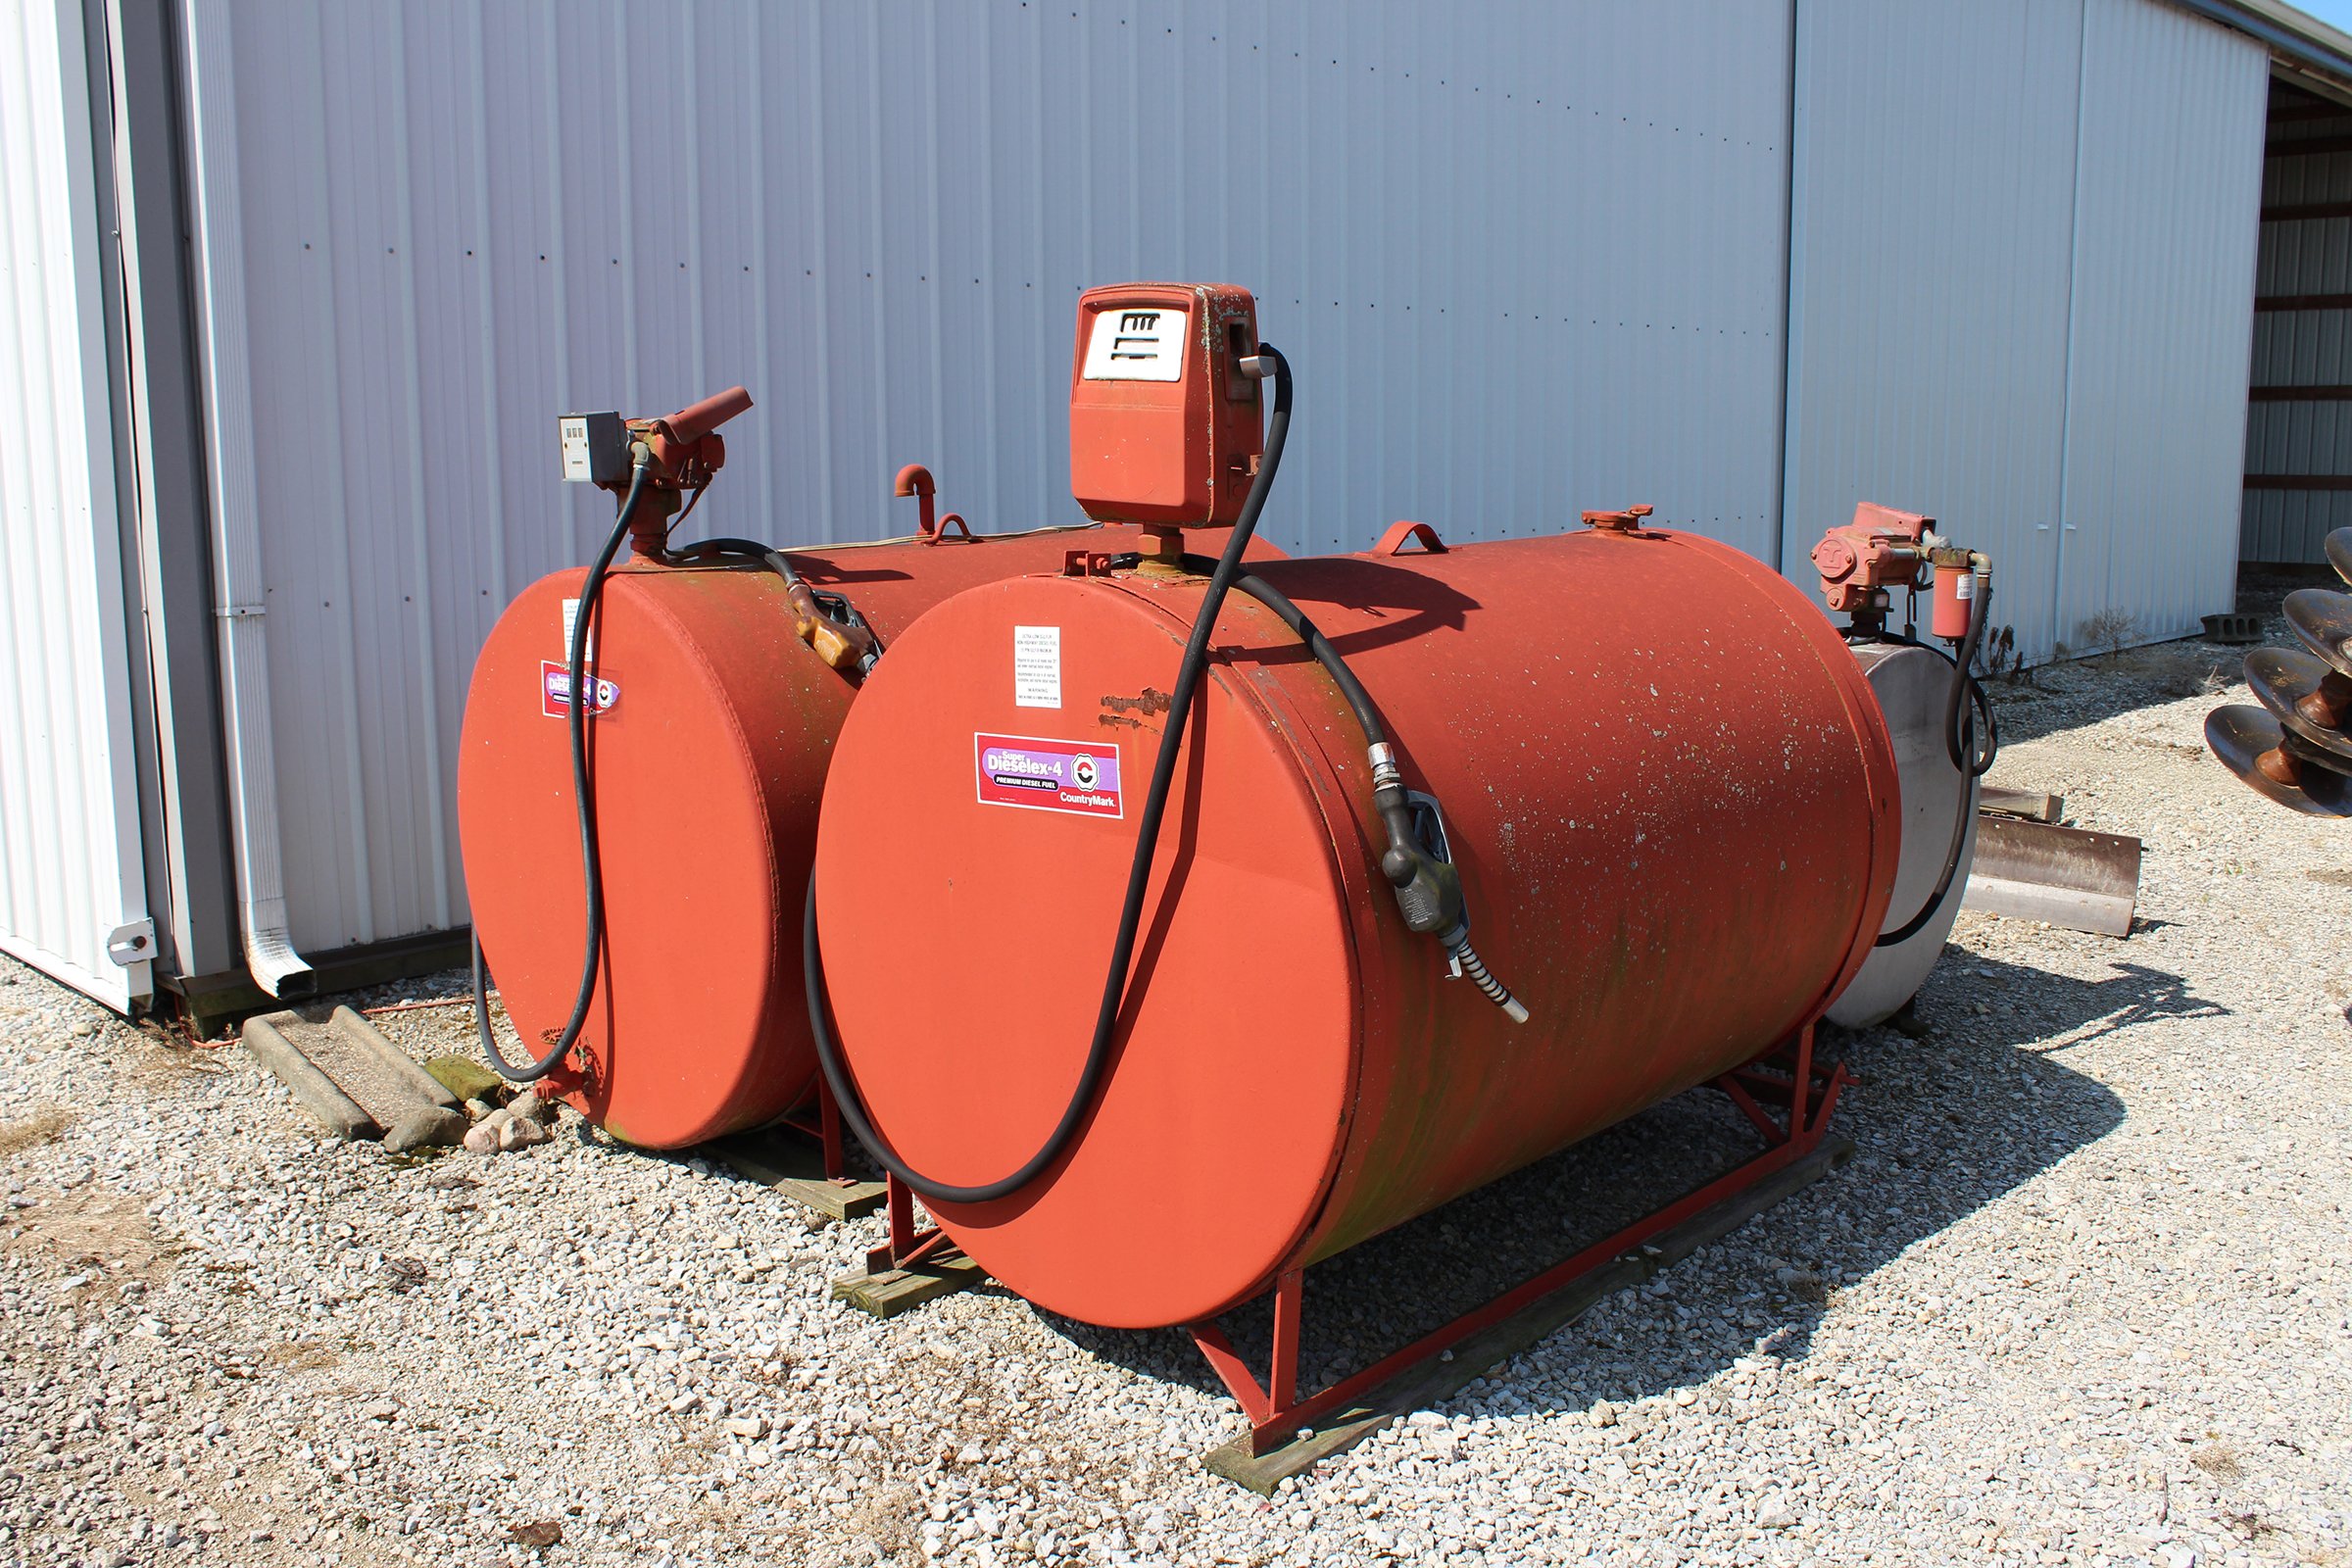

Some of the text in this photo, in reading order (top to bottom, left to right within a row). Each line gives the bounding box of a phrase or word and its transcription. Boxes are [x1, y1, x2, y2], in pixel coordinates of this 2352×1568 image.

[1002, 751, 1025, 761] Super
[988, 754, 1063, 777] Dieselex-4
[996, 776, 1055, 789] PREMIUM DIESEL FUEL
[1060, 792, 1114, 808] CountryMark
